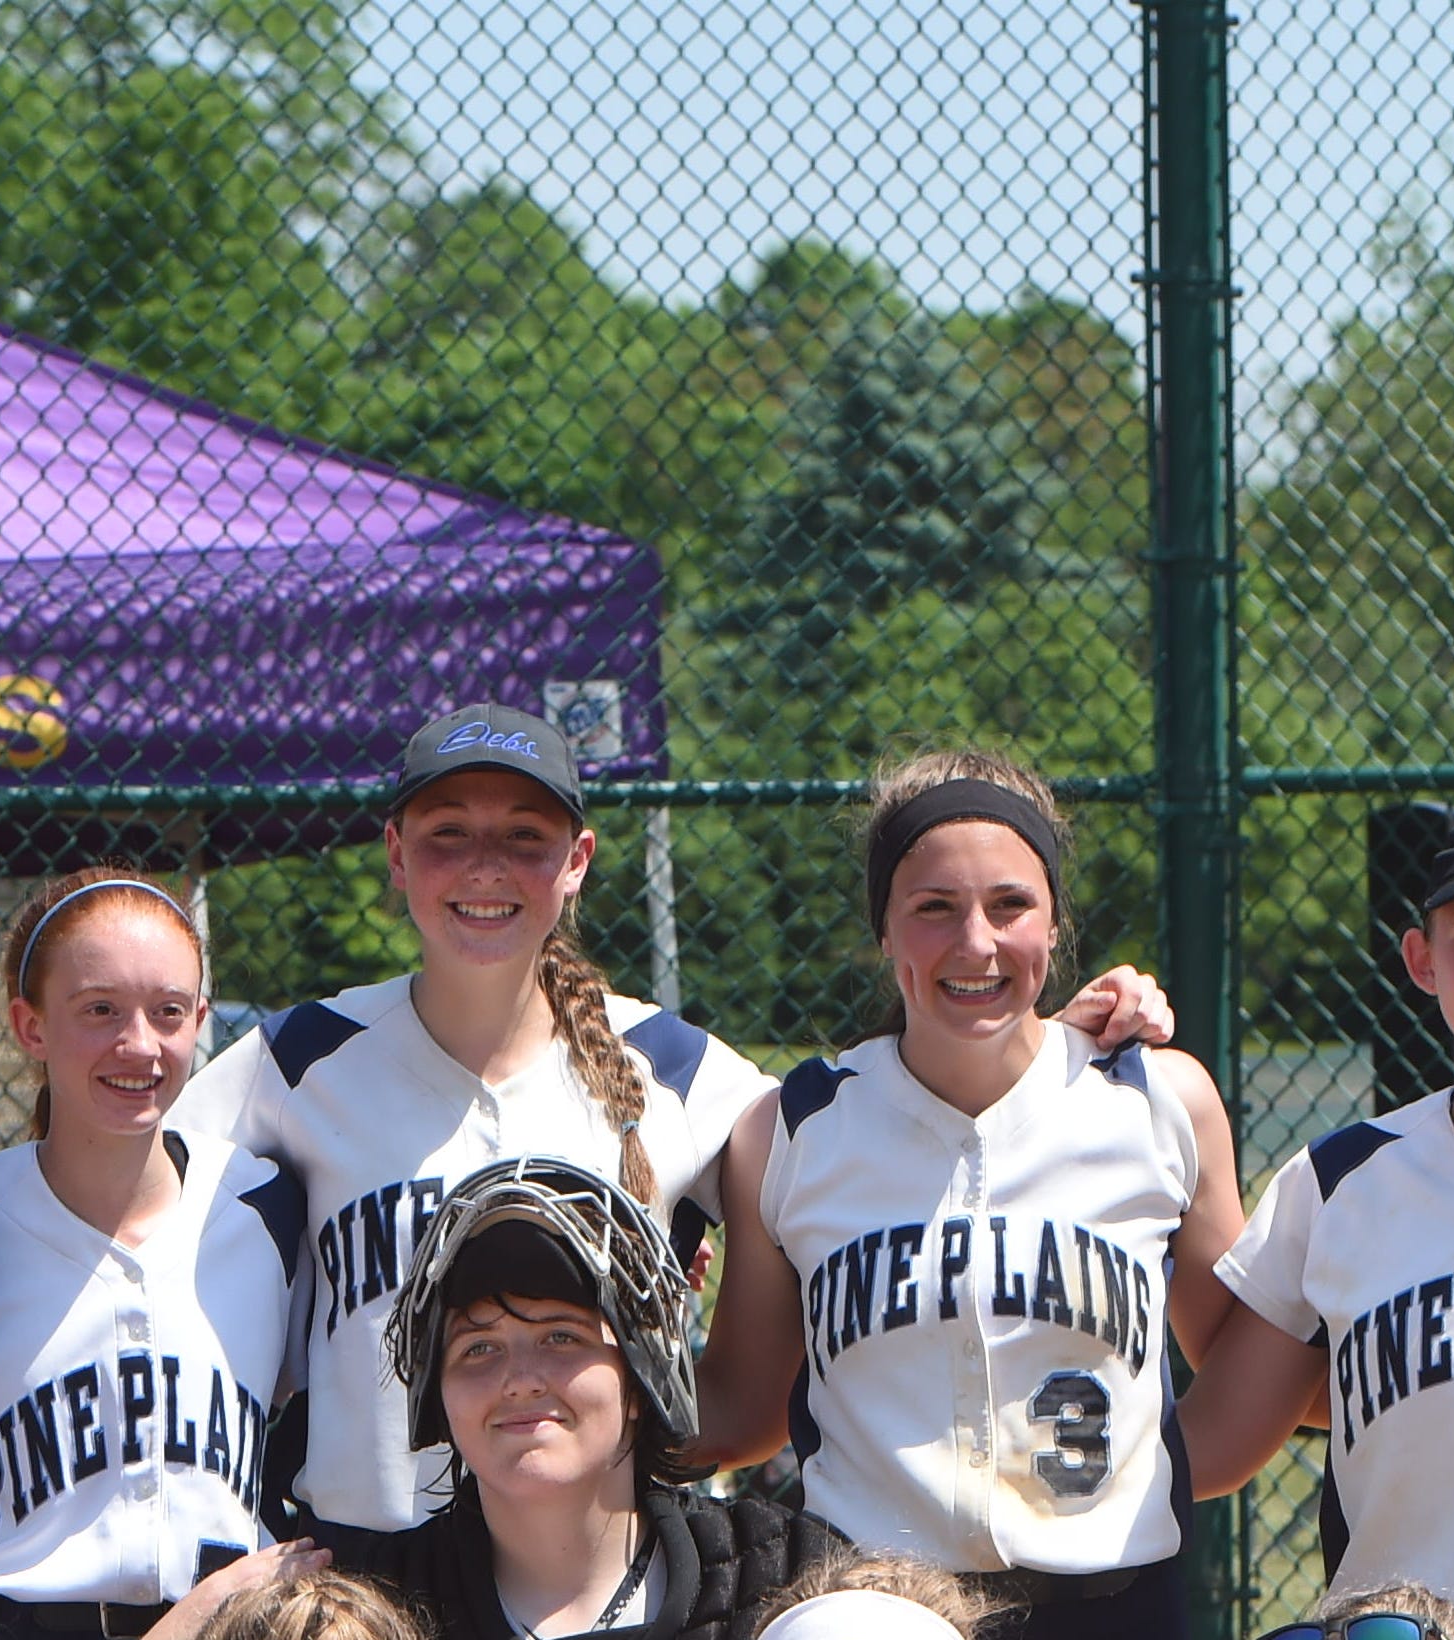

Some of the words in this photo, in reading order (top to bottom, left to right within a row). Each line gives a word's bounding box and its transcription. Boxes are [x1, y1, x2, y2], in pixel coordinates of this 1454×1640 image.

[808, 1222, 926, 1384] PINE
[938, 1213, 1150, 1381] PLAINS
[1336, 1272, 1454, 1455] PINE
[1027, 1367, 1113, 1498] 3
